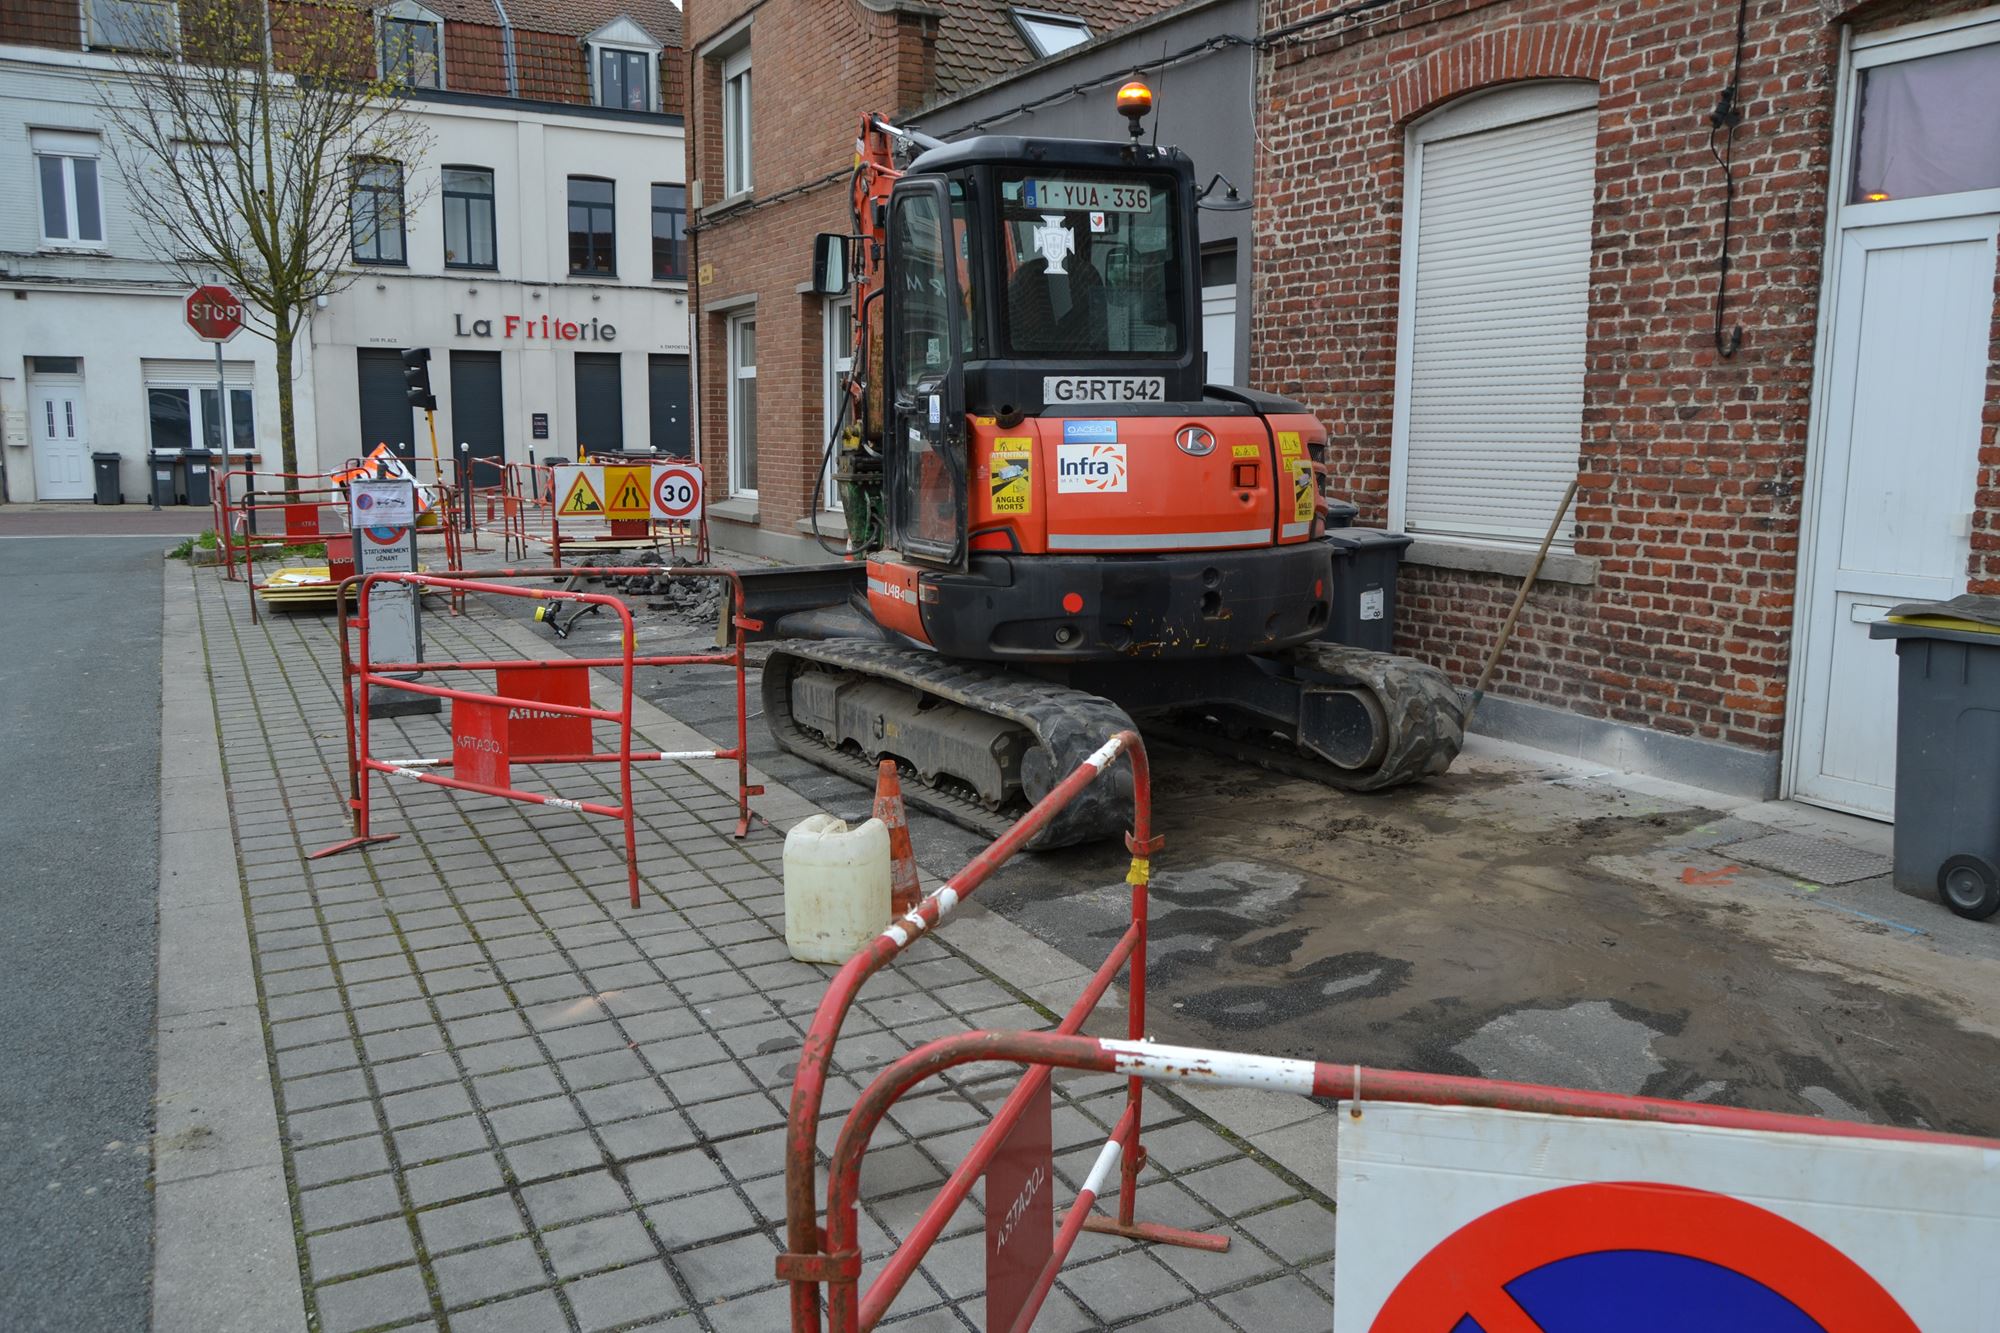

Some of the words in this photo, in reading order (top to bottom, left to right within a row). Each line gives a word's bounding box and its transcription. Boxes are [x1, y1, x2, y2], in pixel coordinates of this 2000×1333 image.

[1028, 195, 1035, 206] B
[1040, 185, 1148, 209] 1-YUA-336
[191, 303, 237, 321] STOP
[454, 313, 492, 338] La
[504, 314, 617, 342] Friterie
[1055, 379, 1161, 401] G5RT542
[1060, 457, 1109, 476] Infra
[663, 484, 691, 503] 30
[363, 547, 410, 556] STATIONNEMENT
